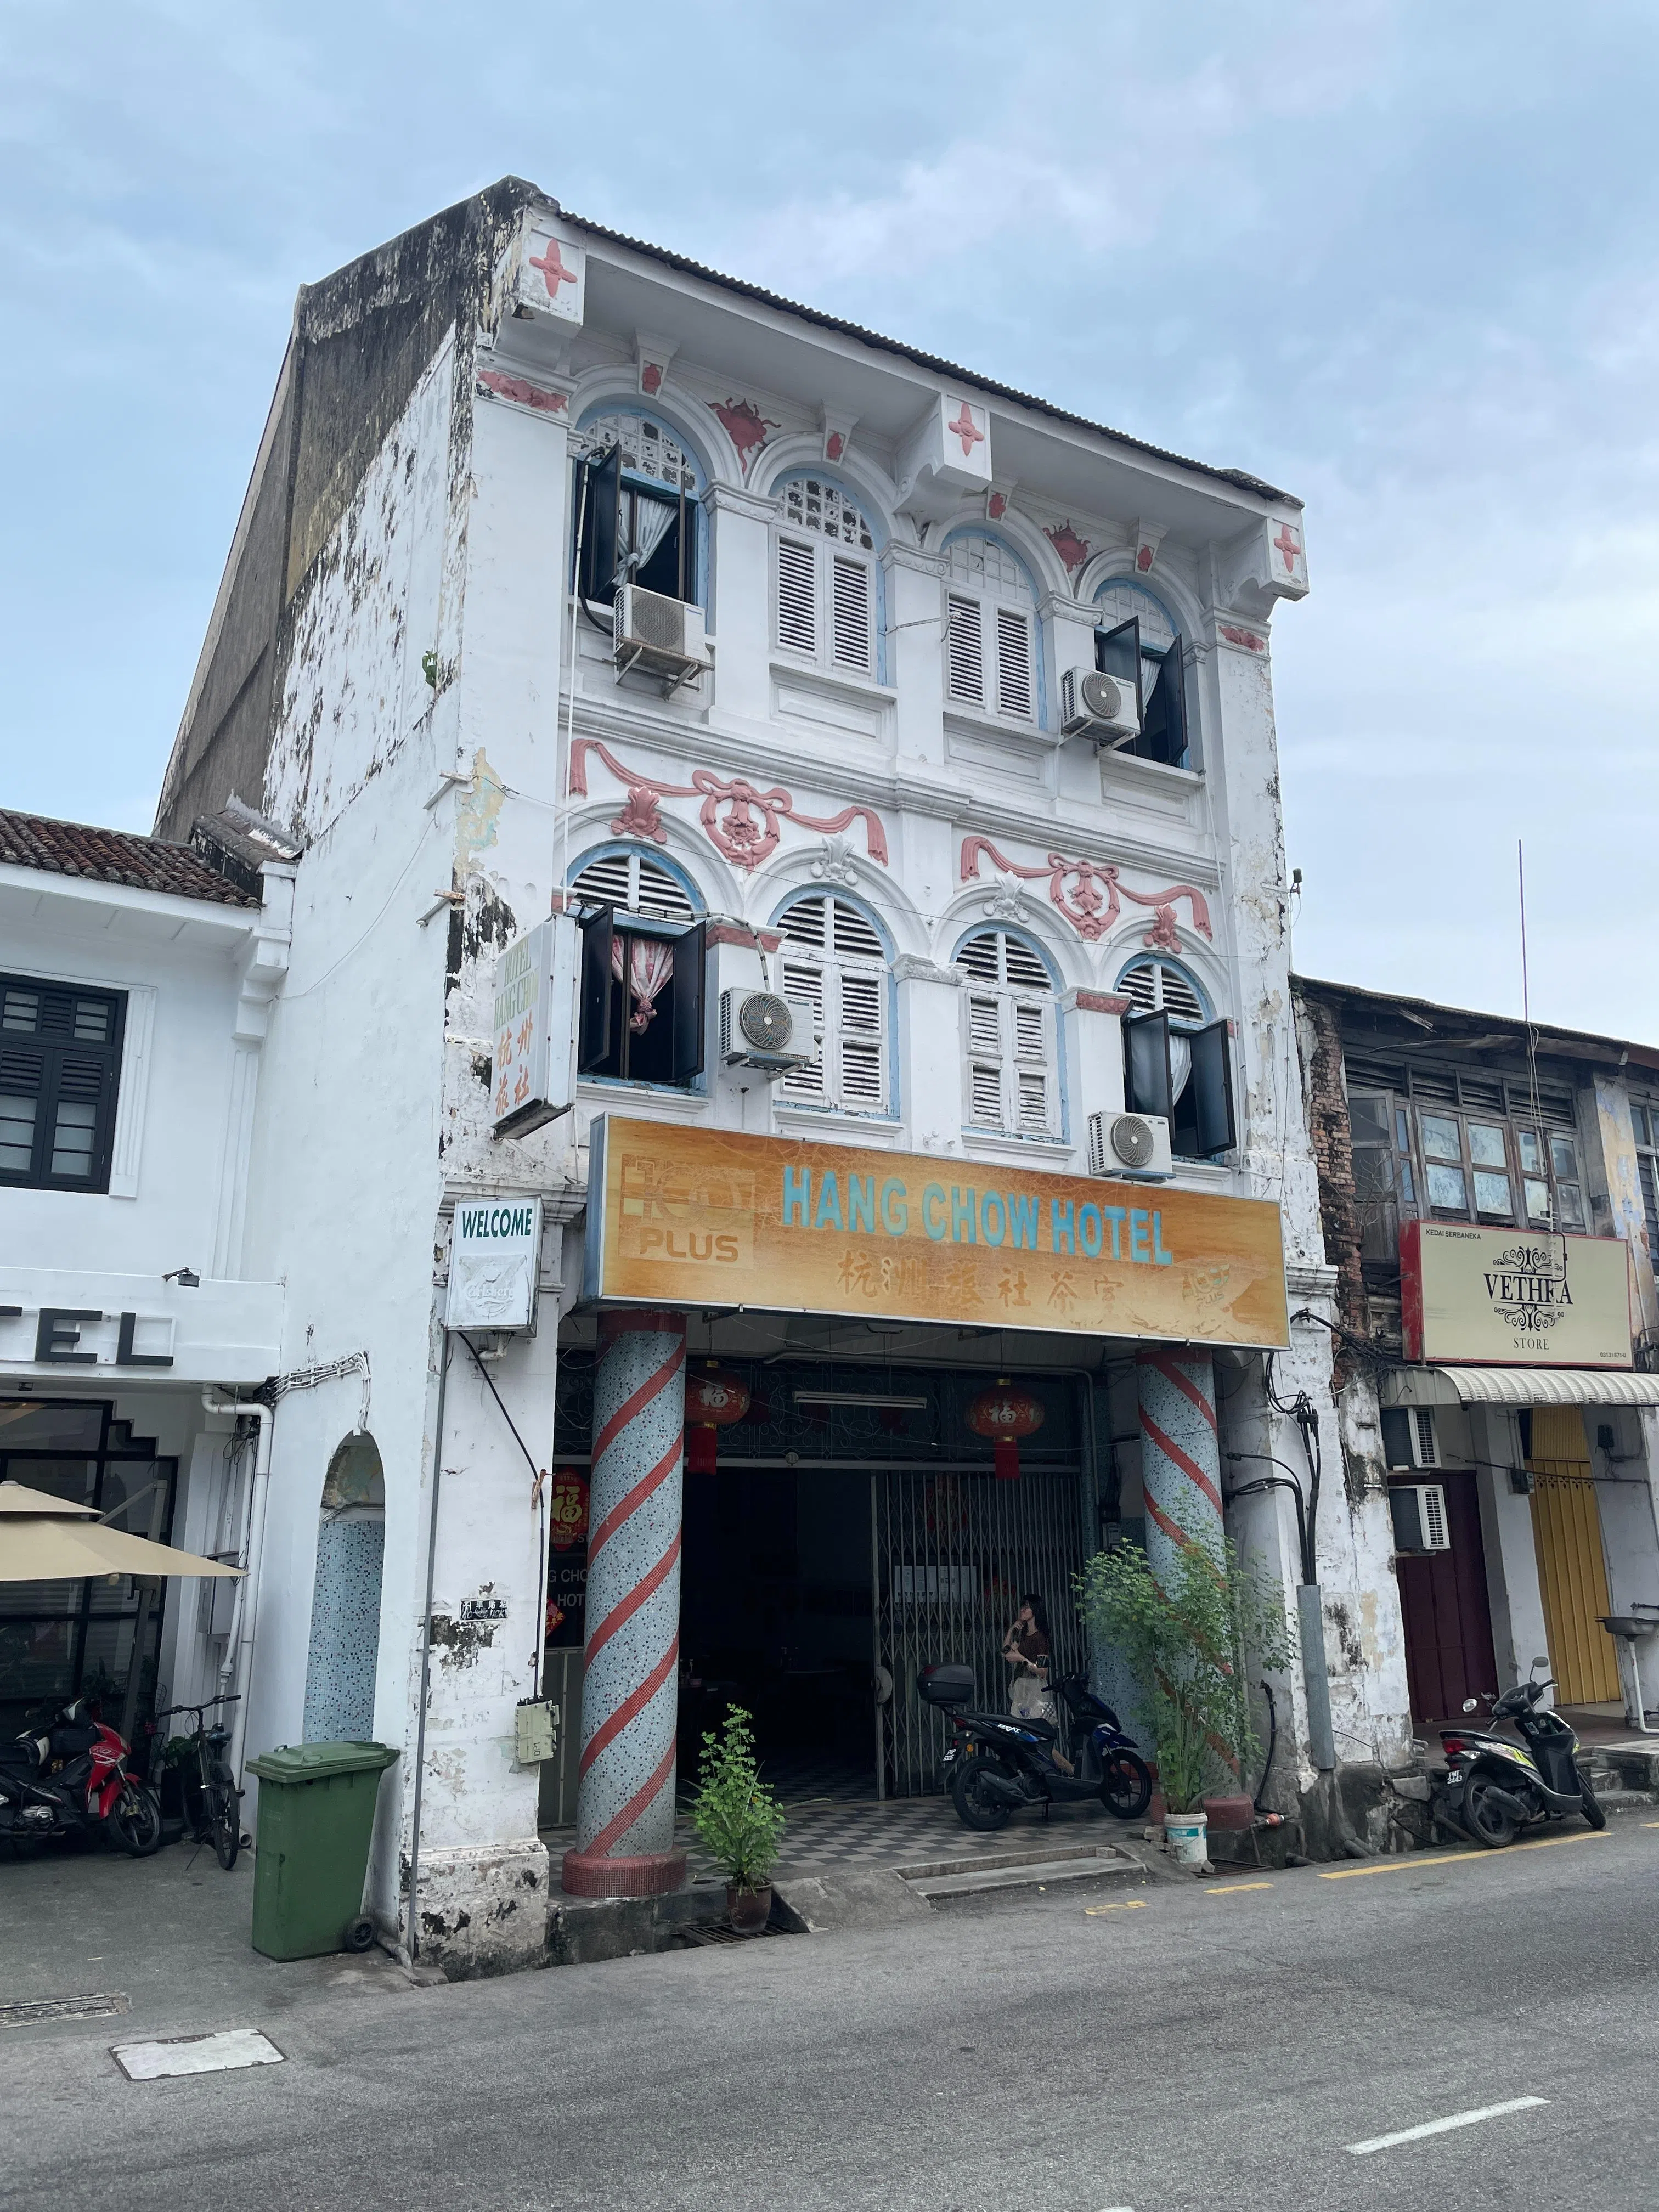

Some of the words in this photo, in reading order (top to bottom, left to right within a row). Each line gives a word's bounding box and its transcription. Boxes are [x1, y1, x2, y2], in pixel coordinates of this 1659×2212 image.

[504, 937, 532, 988] HOTEL
[494, 984, 516, 1032] HANG
[462, 1208, 532, 1238] WELCOME
[782, 1165, 909, 1237] HANG
[922, 1182, 1040, 1251] CHOW
[1051, 1198, 1173, 1265] HOTEL
[640, 1228, 738, 1262] PLUS
[1445, 1231, 1481, 1240] SERBANEKA
[0, 1306, 173, 1366] EL
[1514, 1337, 1550, 1350] STORE
[551, 1485, 583, 1523] 福
